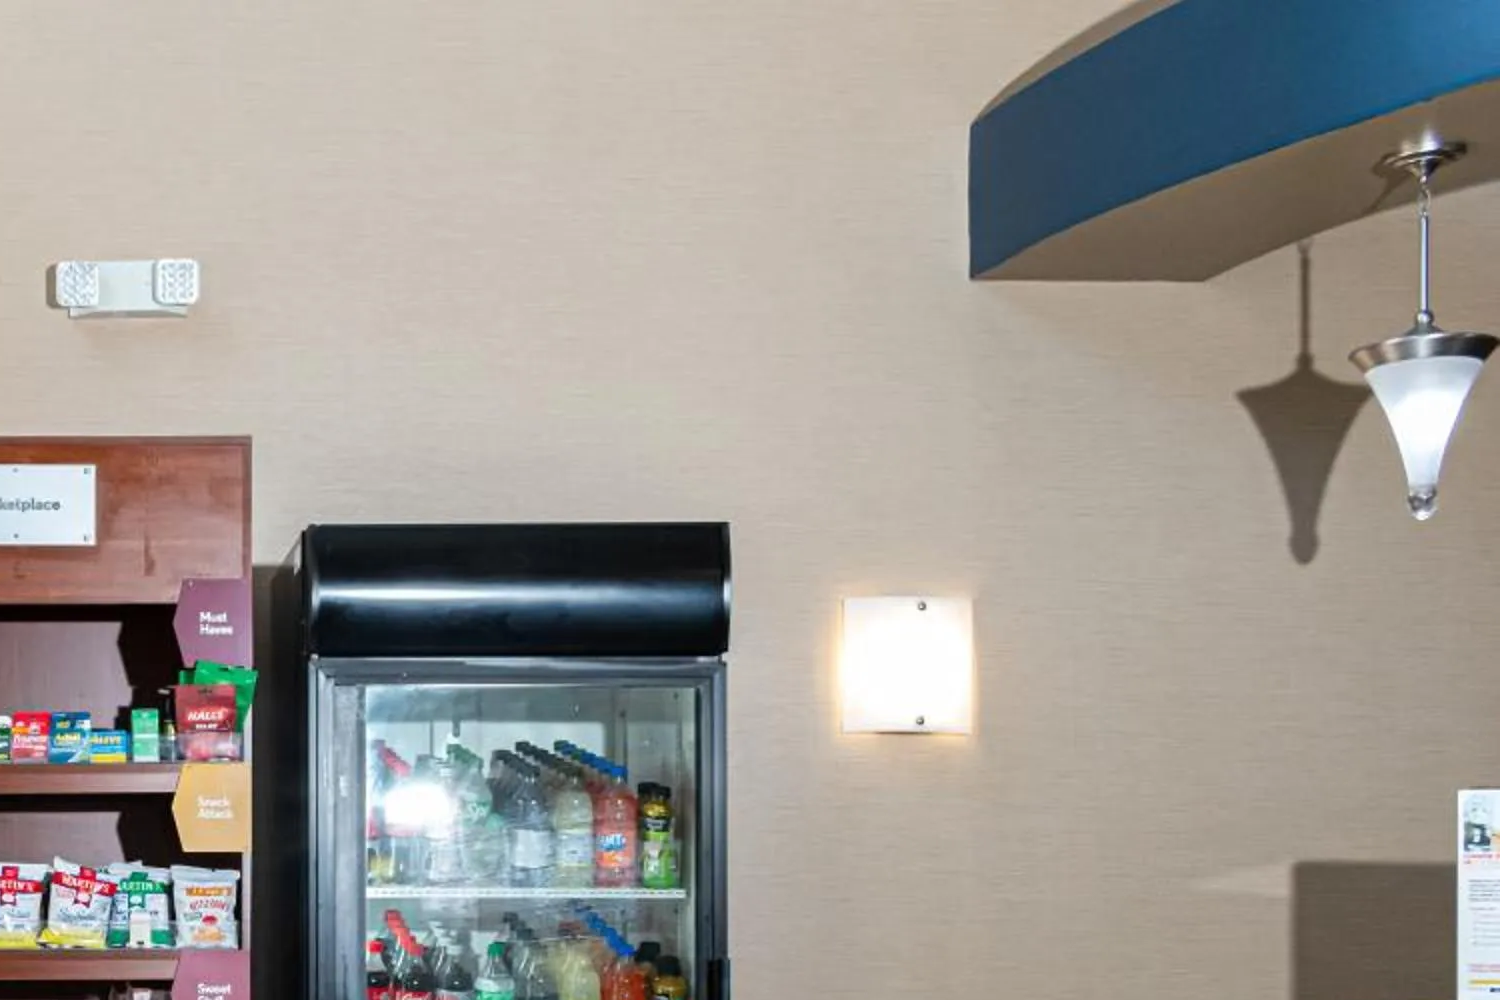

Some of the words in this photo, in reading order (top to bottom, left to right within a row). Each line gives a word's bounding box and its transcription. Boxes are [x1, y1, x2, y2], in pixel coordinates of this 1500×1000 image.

[199, 611, 227, 623] Must
[187, 708, 227, 721] HALLS
[197, 983, 231, 994] Sweet
